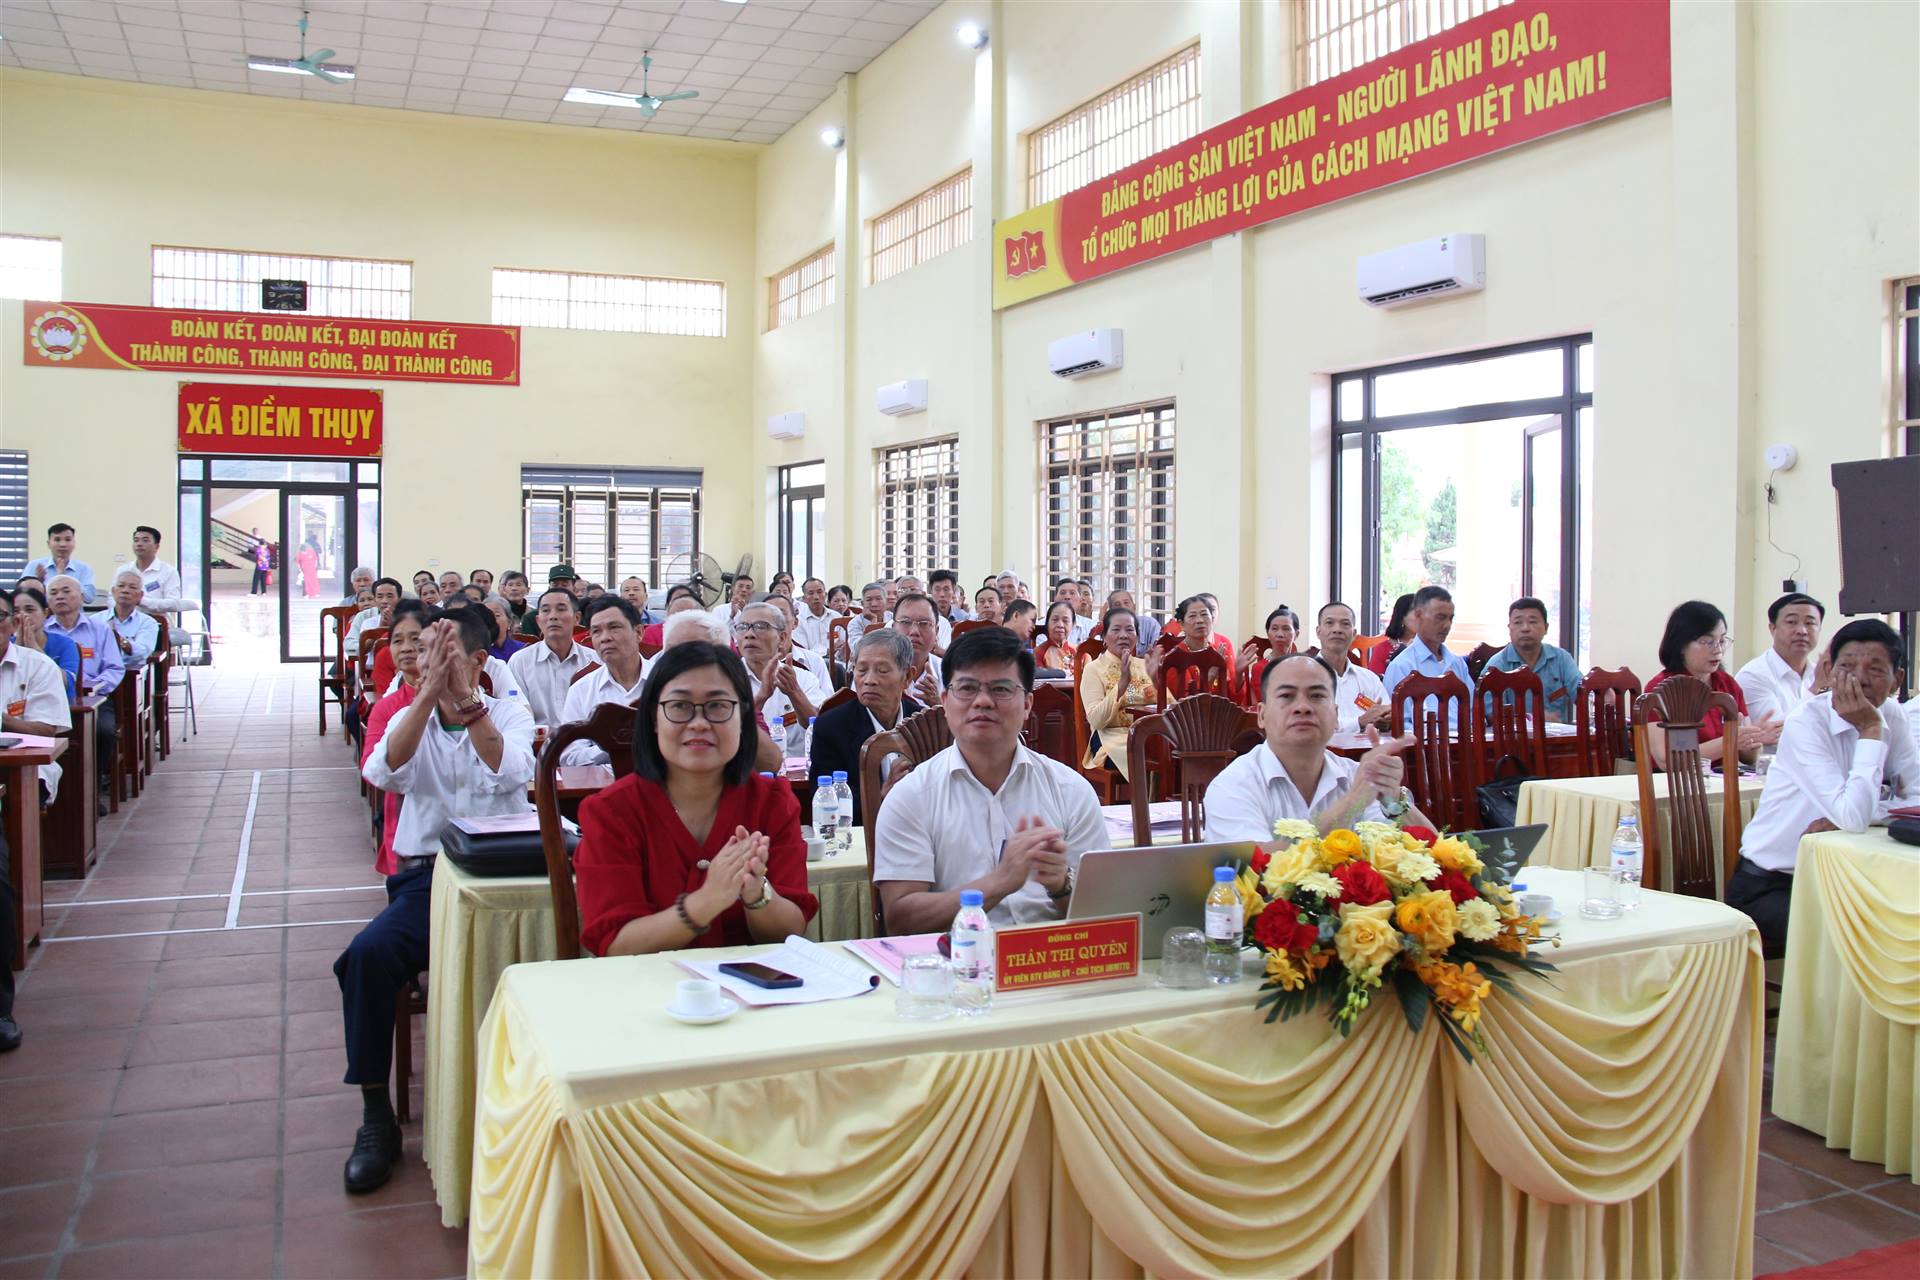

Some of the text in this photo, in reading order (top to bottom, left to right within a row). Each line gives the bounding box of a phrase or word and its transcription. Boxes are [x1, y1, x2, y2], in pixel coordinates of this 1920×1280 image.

[1102, 179, 1139, 218] ĐẢNG
[1143, 161, 1184, 203] CỘNG
[1188, 140, 1222, 183] SẢN
[1227, 125, 1265, 167] VIỆT
[1270, 105, 1316, 152] NAM
[1337, 65, 1408, 126] NGƯỜI
[1415, 38, 1482, 98] LÃNH
[1491, 12, 1557, 68] ĐẠO,
[1082, 51, 1607, 264] TỔ CHỨC MỌI THẮNG LỢI CỦA CÁCH MẠNG VIỆT NAM!
[171, 317, 457, 350] ĐOÀN KẾT, ĐOÀN KẾT, ĐẠI ĐOÀN KẾT
[129, 341, 493, 377] THÀNH CÔNG, THÀNH CÔNG, ĐẠI THÀNH CÔNG
[185, 394, 375, 446] XÃ ĐIỀM THỤY
[1051, 948, 1076, 964] THỊ
